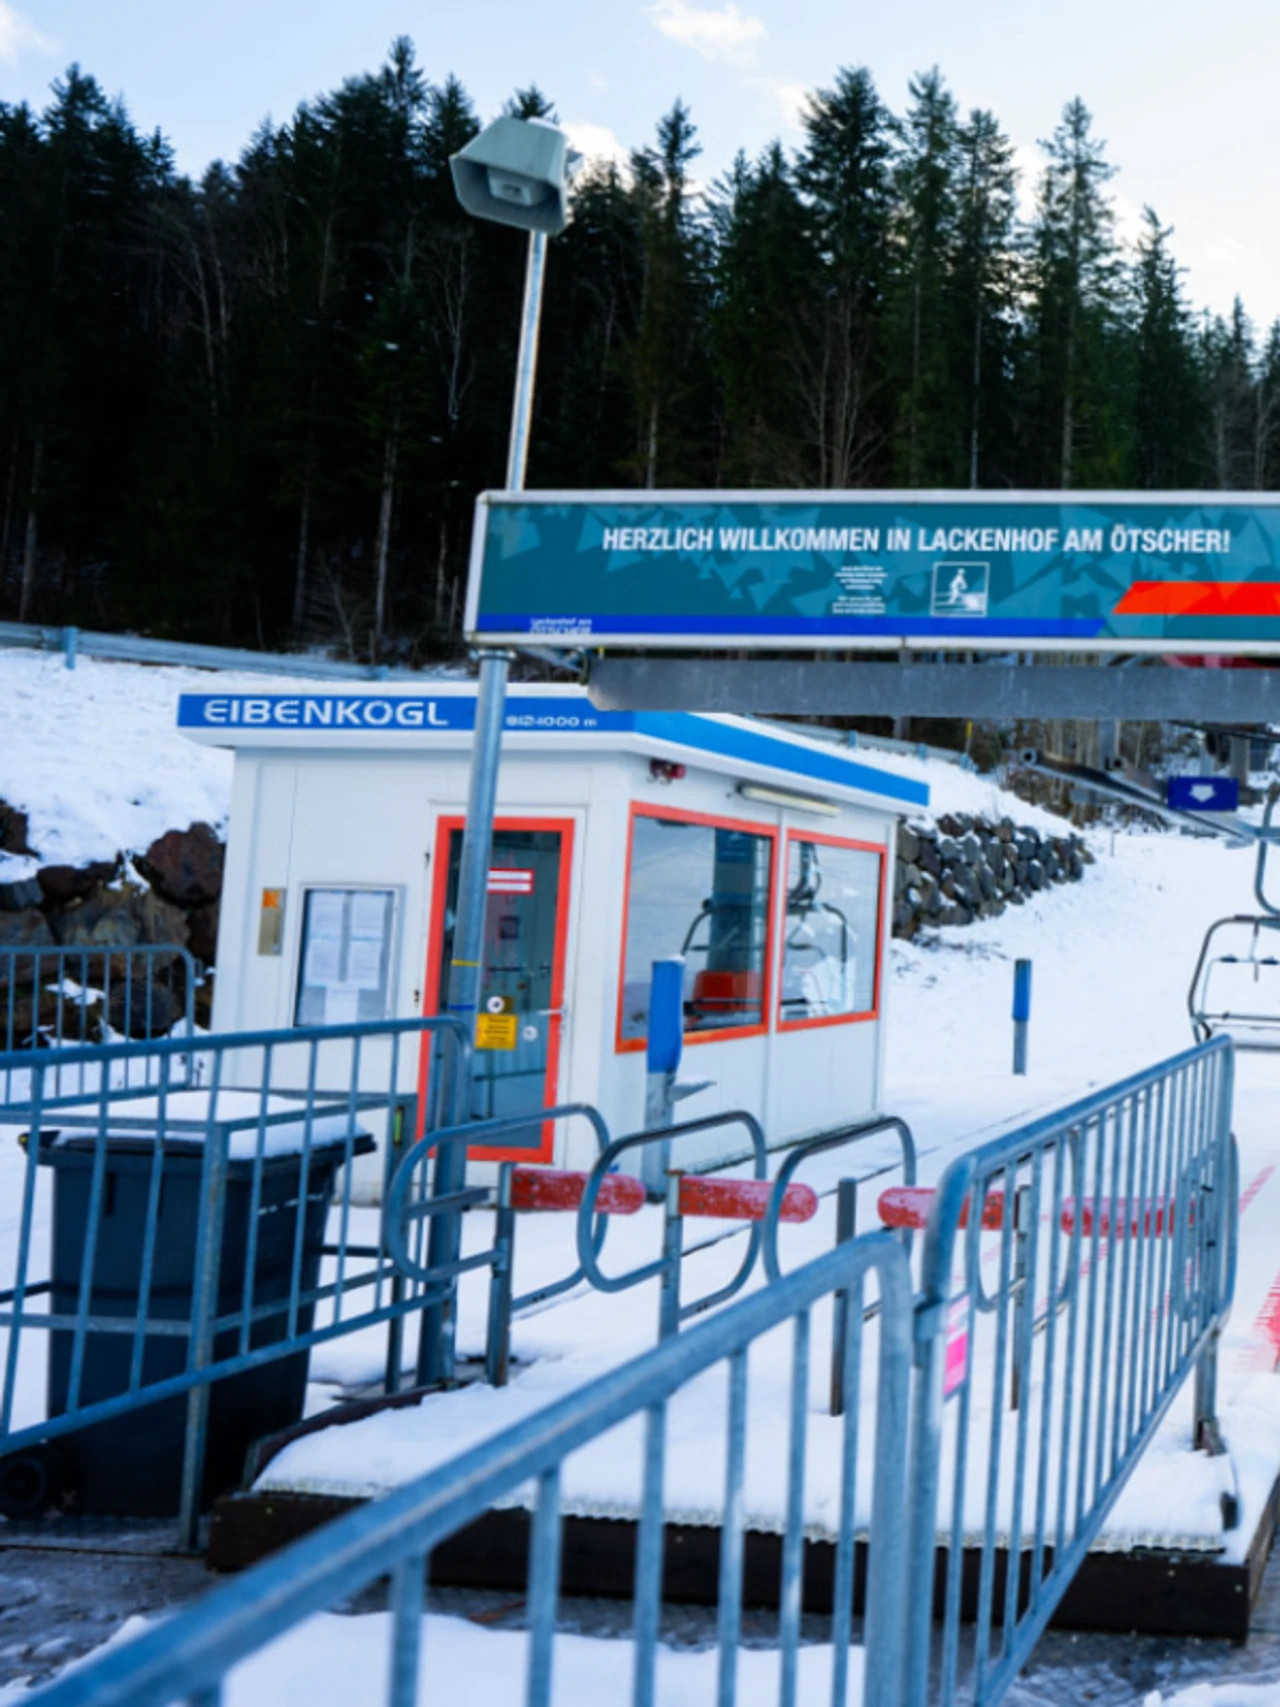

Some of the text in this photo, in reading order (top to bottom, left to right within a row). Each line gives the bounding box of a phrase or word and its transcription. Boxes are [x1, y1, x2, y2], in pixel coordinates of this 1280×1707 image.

[602, 524, 1231, 553] HERZLICH WILLKOMMEN IN LACKENHOF AM ÖTSCHER!
[203, 699, 449, 726] EIBENKOGL
